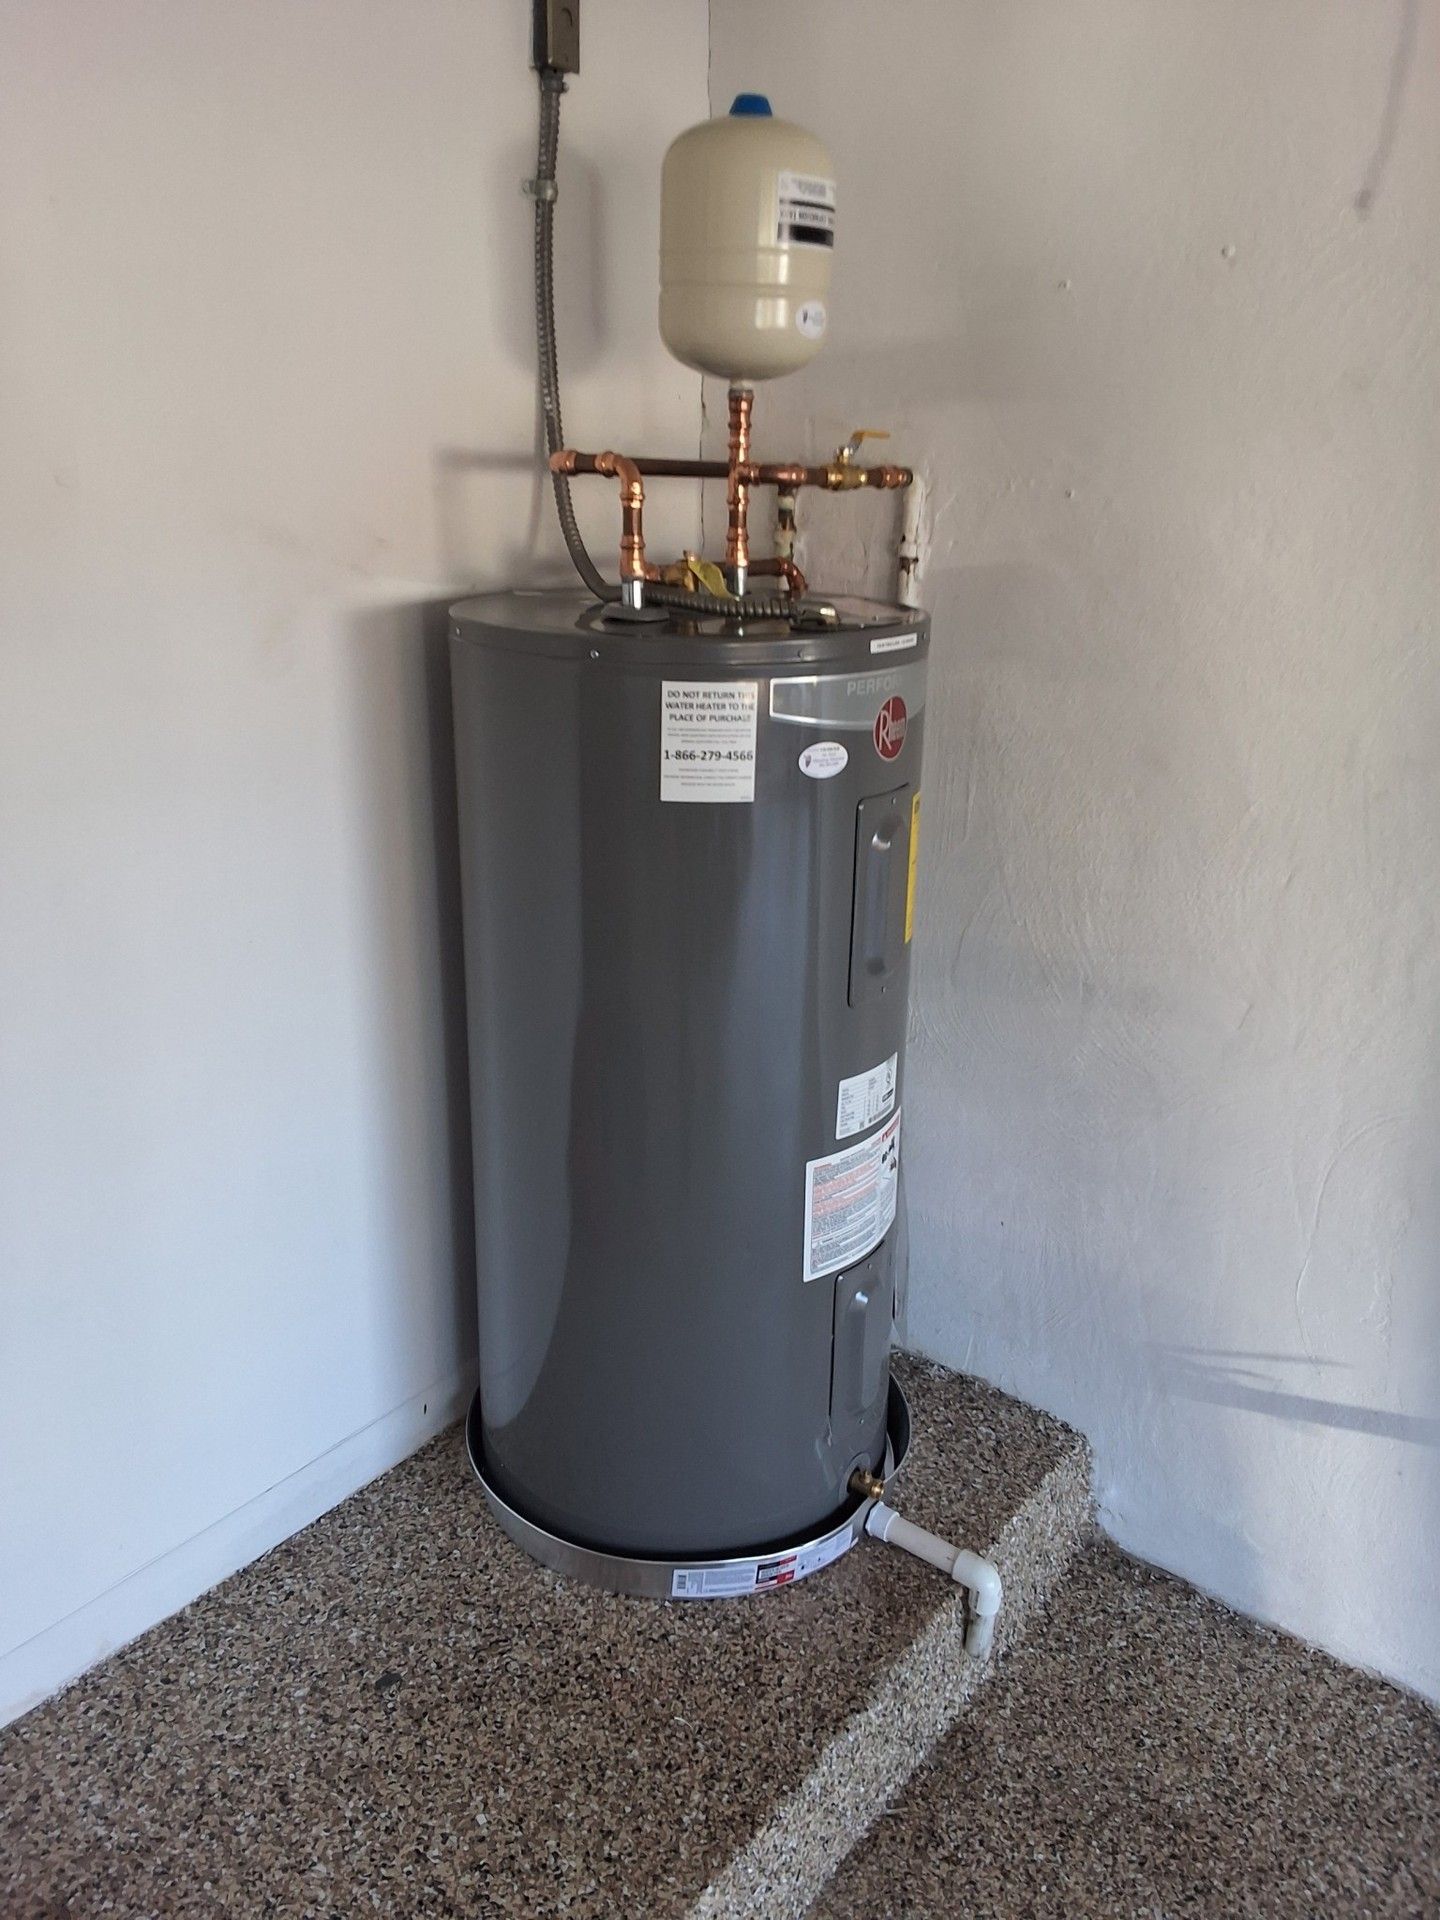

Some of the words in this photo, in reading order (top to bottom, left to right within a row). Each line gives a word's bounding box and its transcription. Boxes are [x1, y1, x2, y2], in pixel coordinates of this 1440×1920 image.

[667, 690, 680, 699] DO
[682, 690, 700, 699] NOT
[702, 690, 735, 699] RETURN
[738, 691, 755, 699] TH
[665, 702, 694, 710] WATER
[696, 702, 726, 710] HEATER
[728, 702, 740, 710] TO
[741, 703, 754, 711] THE
[669, 714, 694, 722] PLACE
[696, 714, 706, 722] OF
[664, 749, 754, 761] 1-866-279-4566
